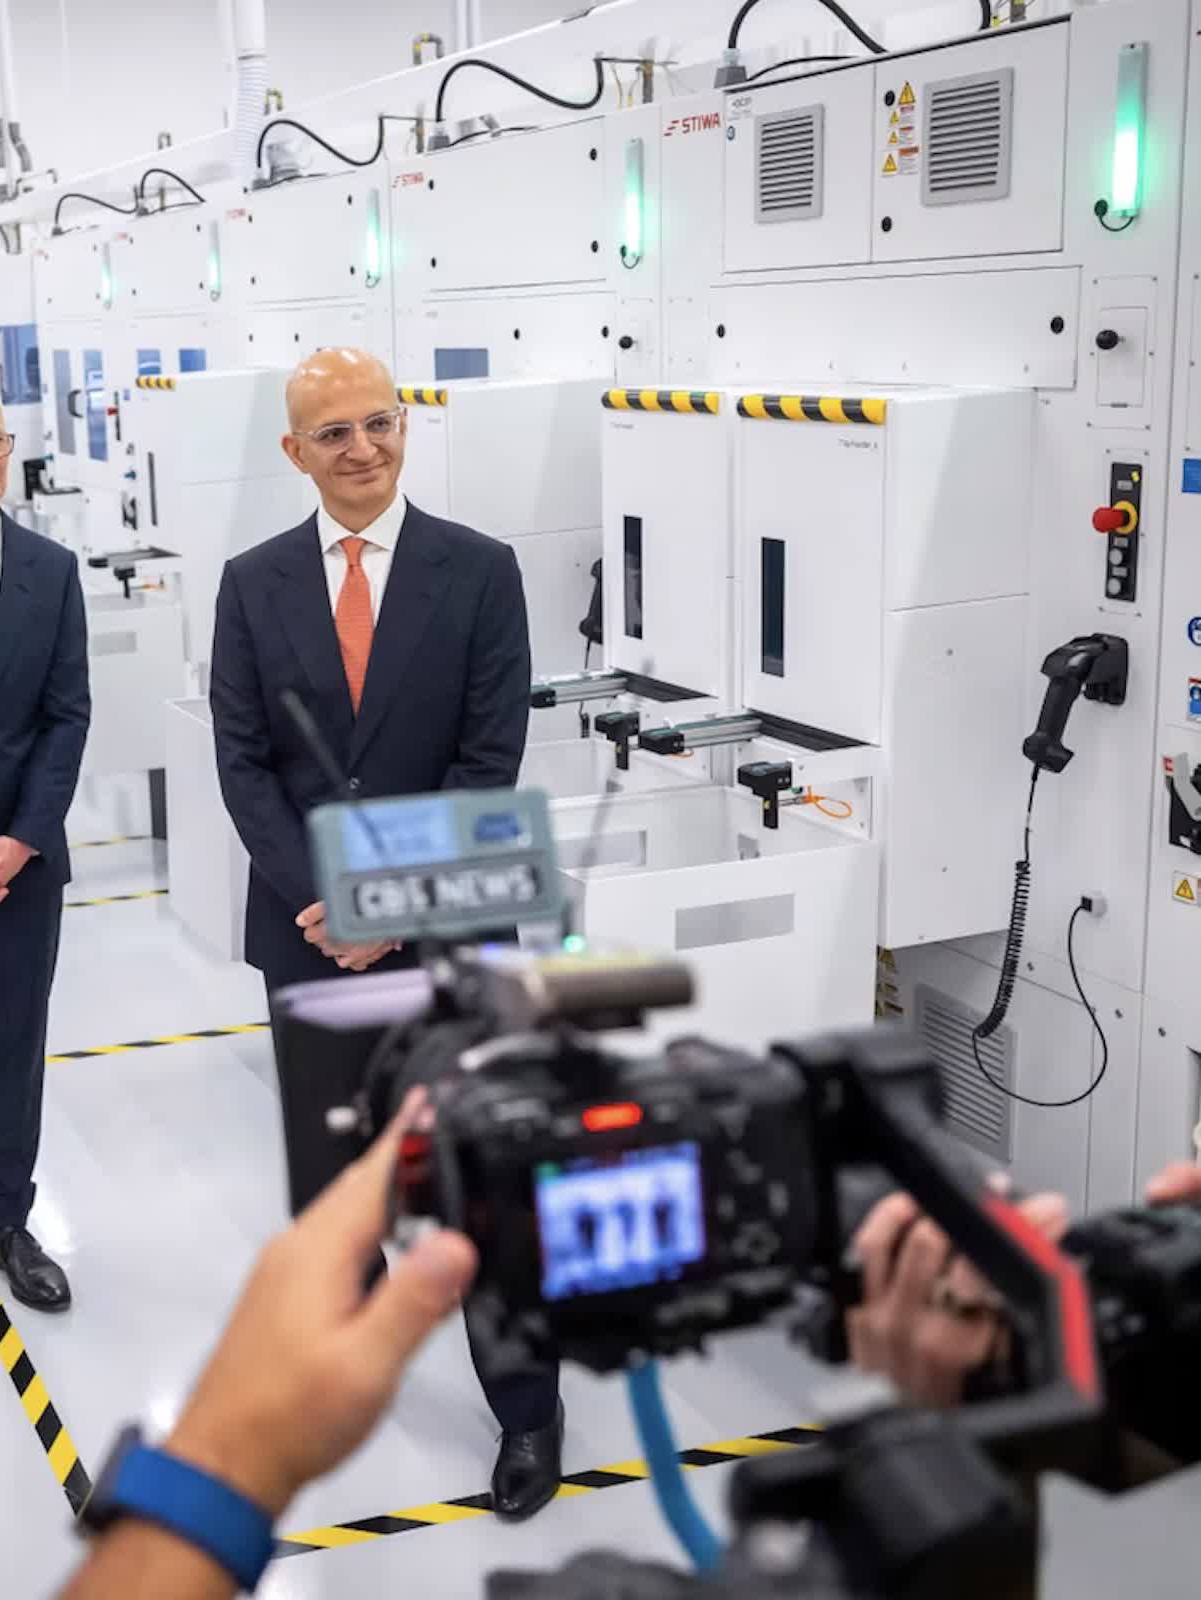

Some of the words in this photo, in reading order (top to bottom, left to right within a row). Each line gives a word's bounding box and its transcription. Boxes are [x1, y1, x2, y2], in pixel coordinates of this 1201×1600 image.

[682, 112, 720, 134] STIWA
[358, 875, 428, 920] CBS
[434, 863, 536, 908] NEWS
